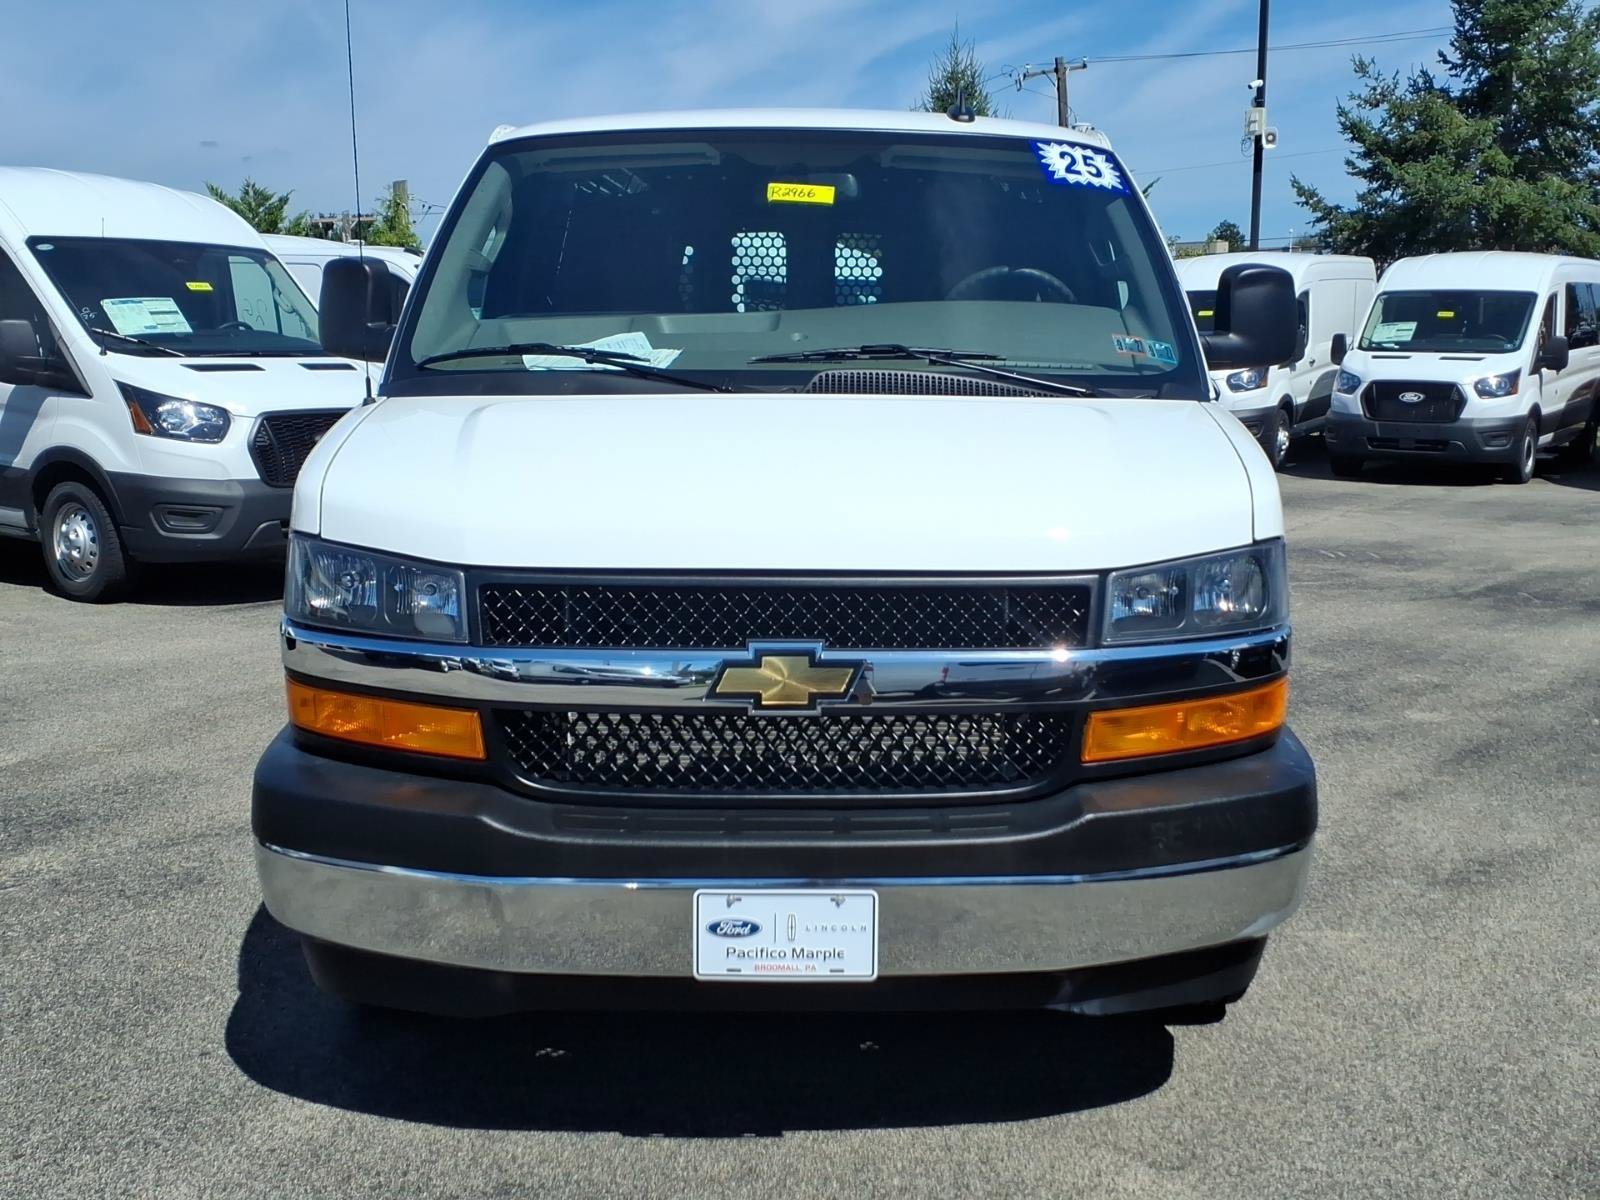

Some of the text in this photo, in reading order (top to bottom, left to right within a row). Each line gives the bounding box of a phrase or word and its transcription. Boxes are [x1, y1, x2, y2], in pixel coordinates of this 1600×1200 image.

[1059, 151, 1103, 178] 25
[771, 186, 817, 198] R2966
[717, 920, 750, 937] Ford
[726, 947, 845, 961] Pacifico Marple
[805, 964, 816, 972] PA
